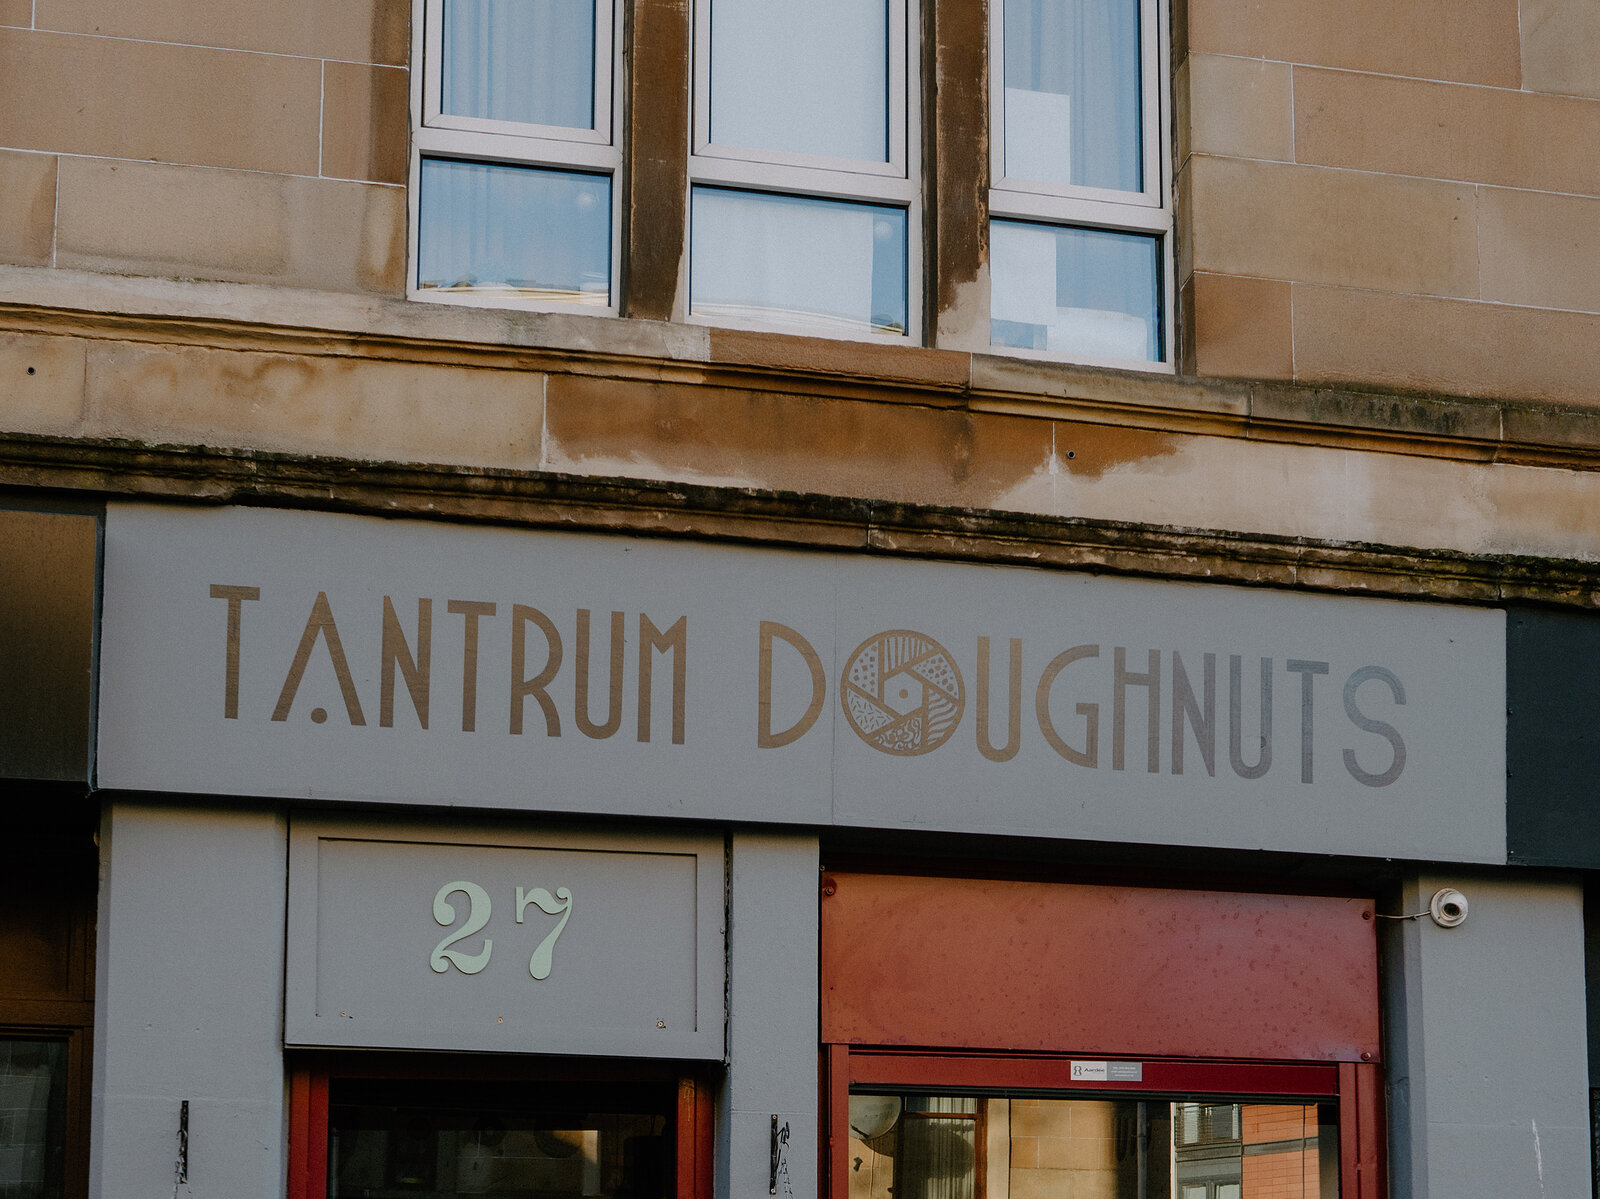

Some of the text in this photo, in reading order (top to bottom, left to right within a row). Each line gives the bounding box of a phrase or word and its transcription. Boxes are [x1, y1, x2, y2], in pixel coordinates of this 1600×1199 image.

[210, 584, 1407, 788] TANTRUM DOUGHNUTS
[430, 881, 573, 980] 27
